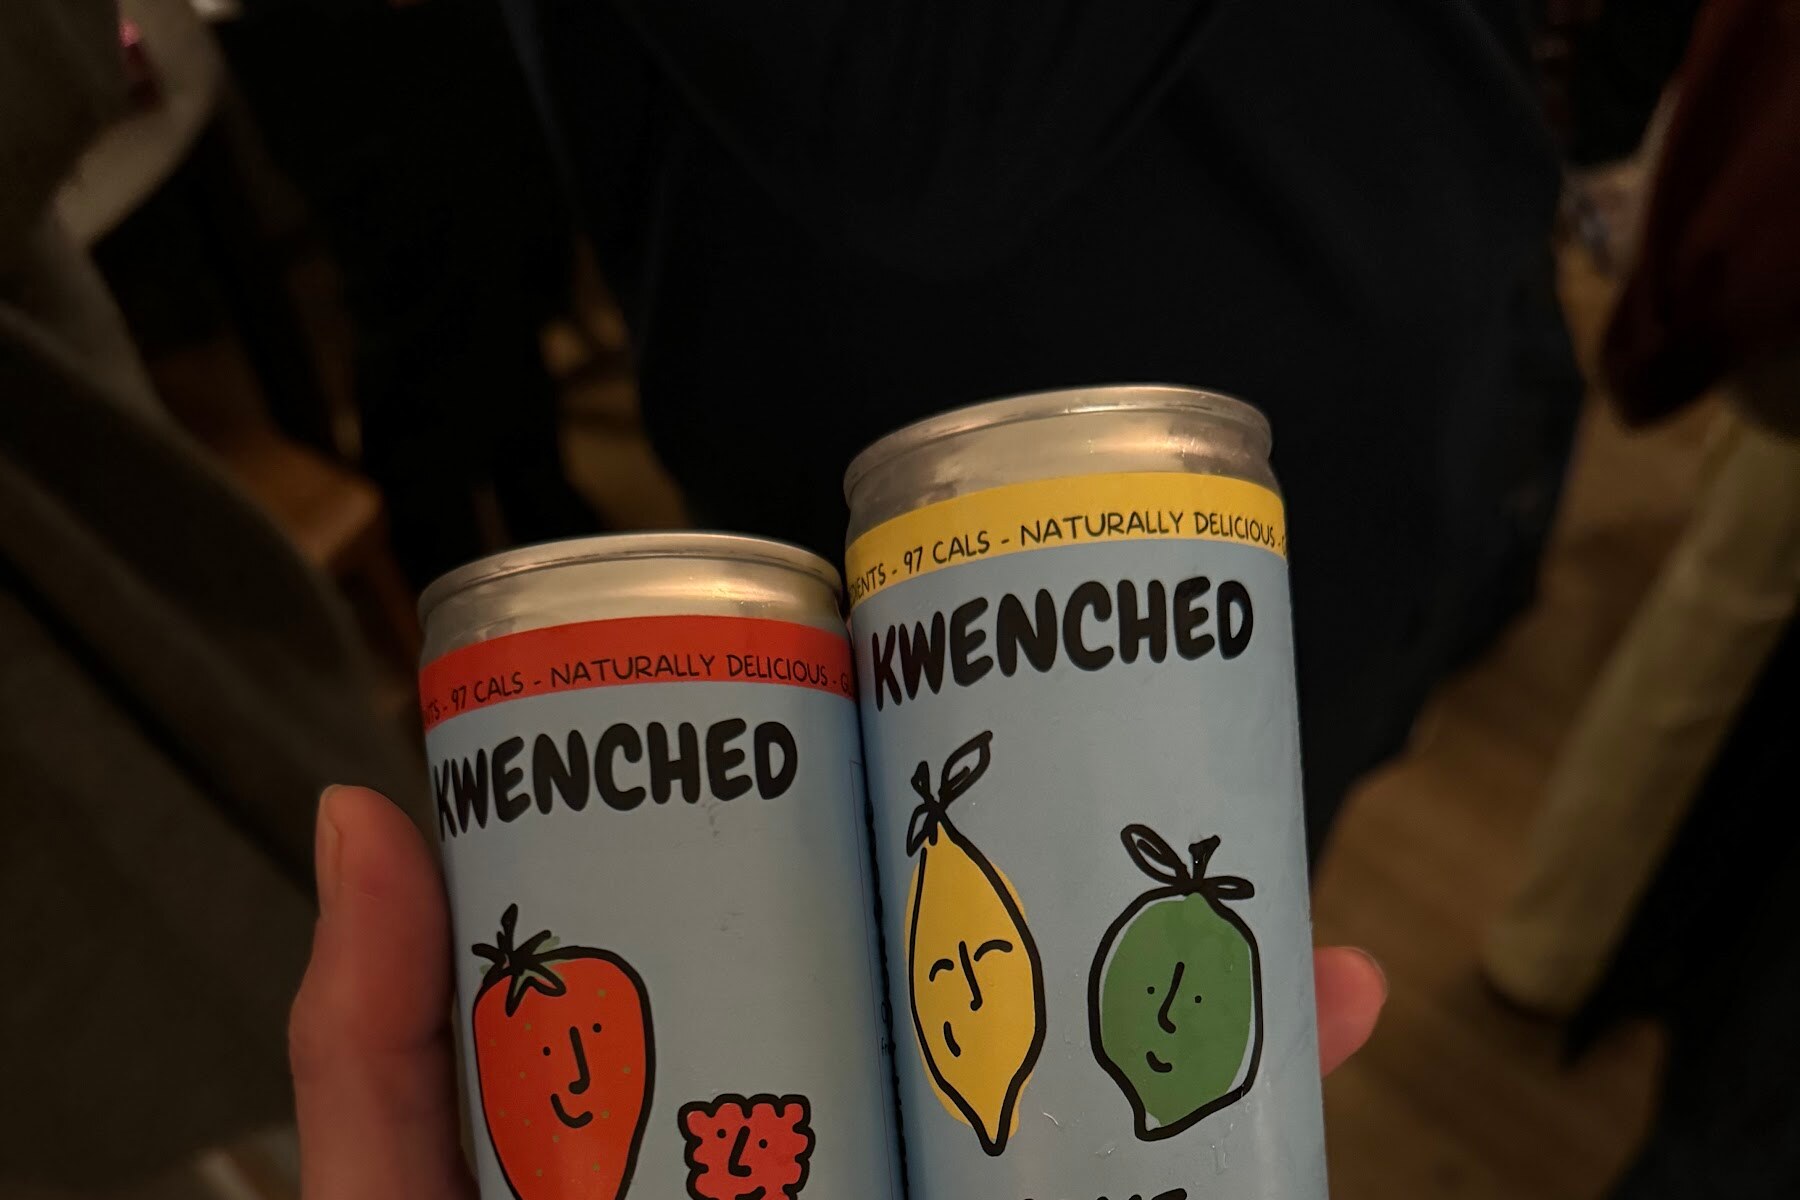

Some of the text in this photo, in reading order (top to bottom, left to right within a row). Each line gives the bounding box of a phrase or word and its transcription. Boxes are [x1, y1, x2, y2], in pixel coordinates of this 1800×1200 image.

[903, 546, 923, 575] 97
[932, 530, 991, 565] CALS
[1020, 511, 1184, 546] NATURALLY
[1193, 511, 1276, 548] DELICIOUS
[451, 685, 468, 711] 97
[474, 671, 525, 703] CALS
[550, 653, 716, 688] NATURALLY
[726, 654, 829, 687] DELICIOUS
[872, 576, 1254, 711] KWENCHED
[433, 718, 798, 841] KWENCHED
